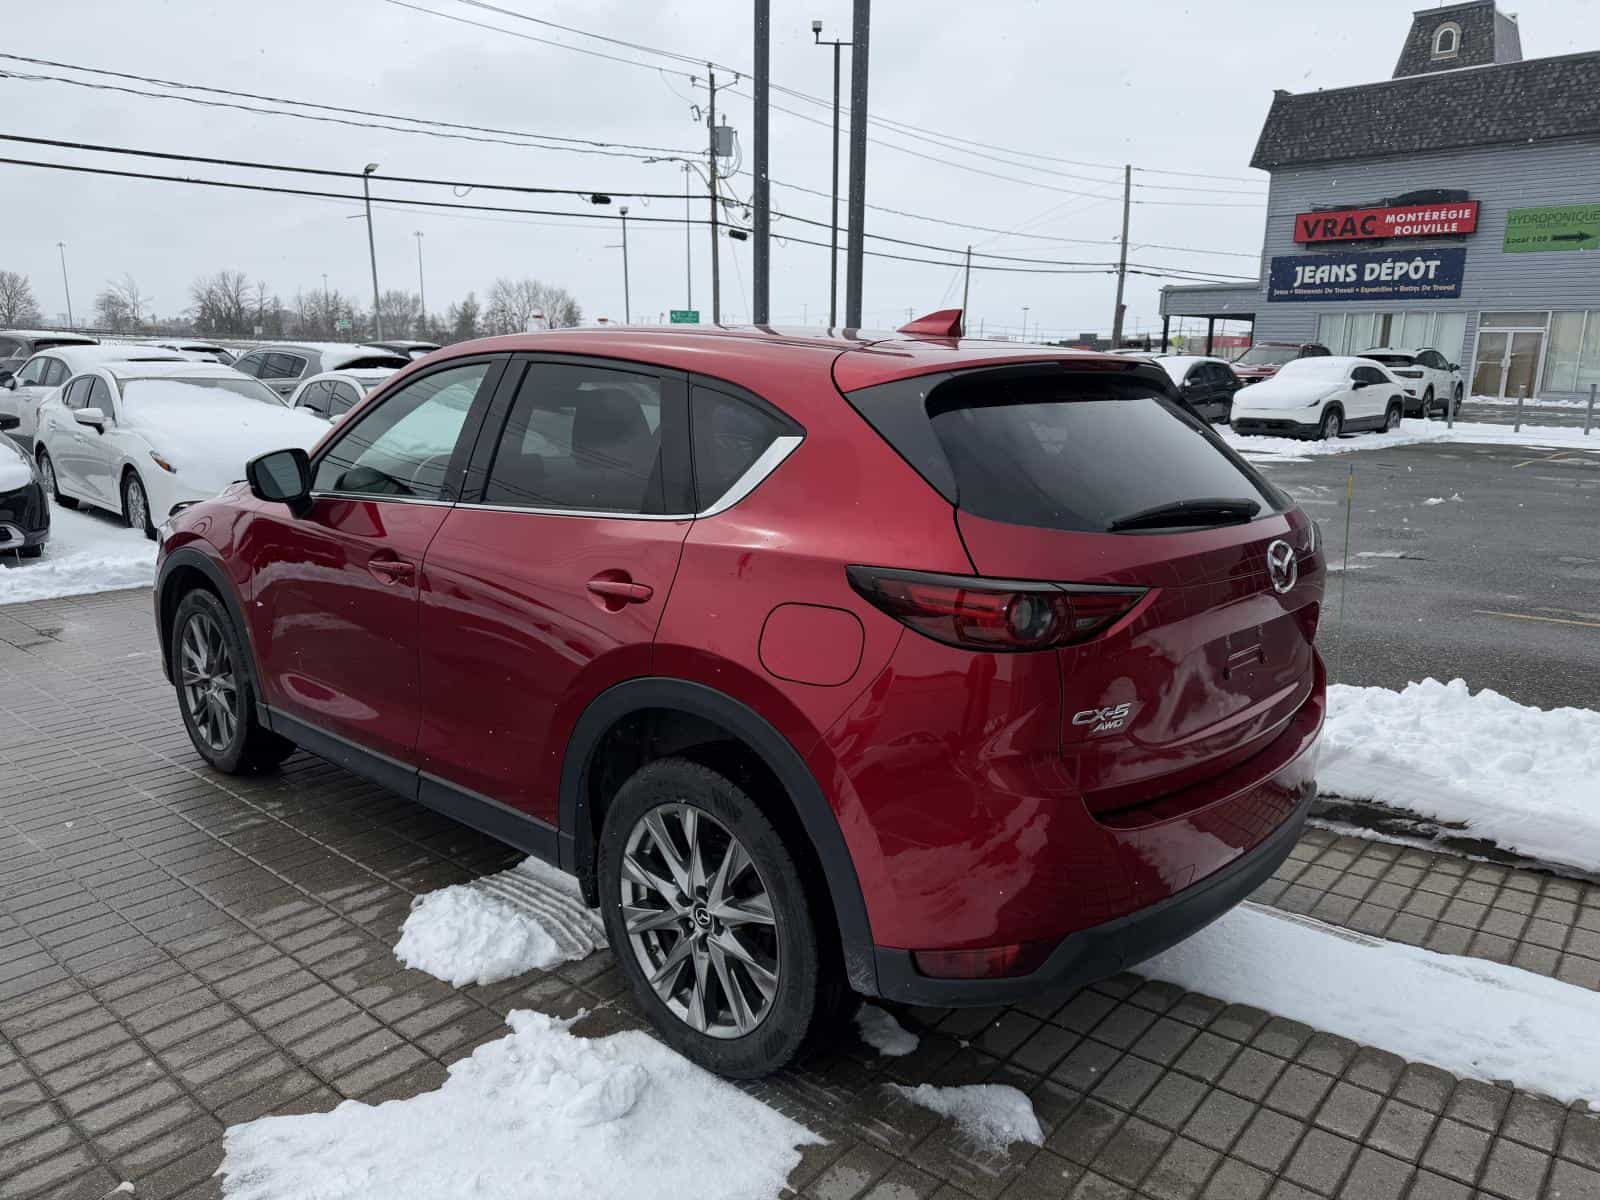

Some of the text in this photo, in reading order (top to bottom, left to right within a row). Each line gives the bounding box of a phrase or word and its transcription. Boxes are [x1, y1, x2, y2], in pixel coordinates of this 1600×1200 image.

[1385, 208, 1471, 224] MONTÉRÉGIE
[1303, 215, 1377, 239] VRAC
[1394, 222, 1459, 235] ROUVILLE
[1293, 257, 1441, 287] JEANS DÉPÔT
[1072, 702, 1132, 725] CX-5
[1093, 719, 1124, 734] AWD
